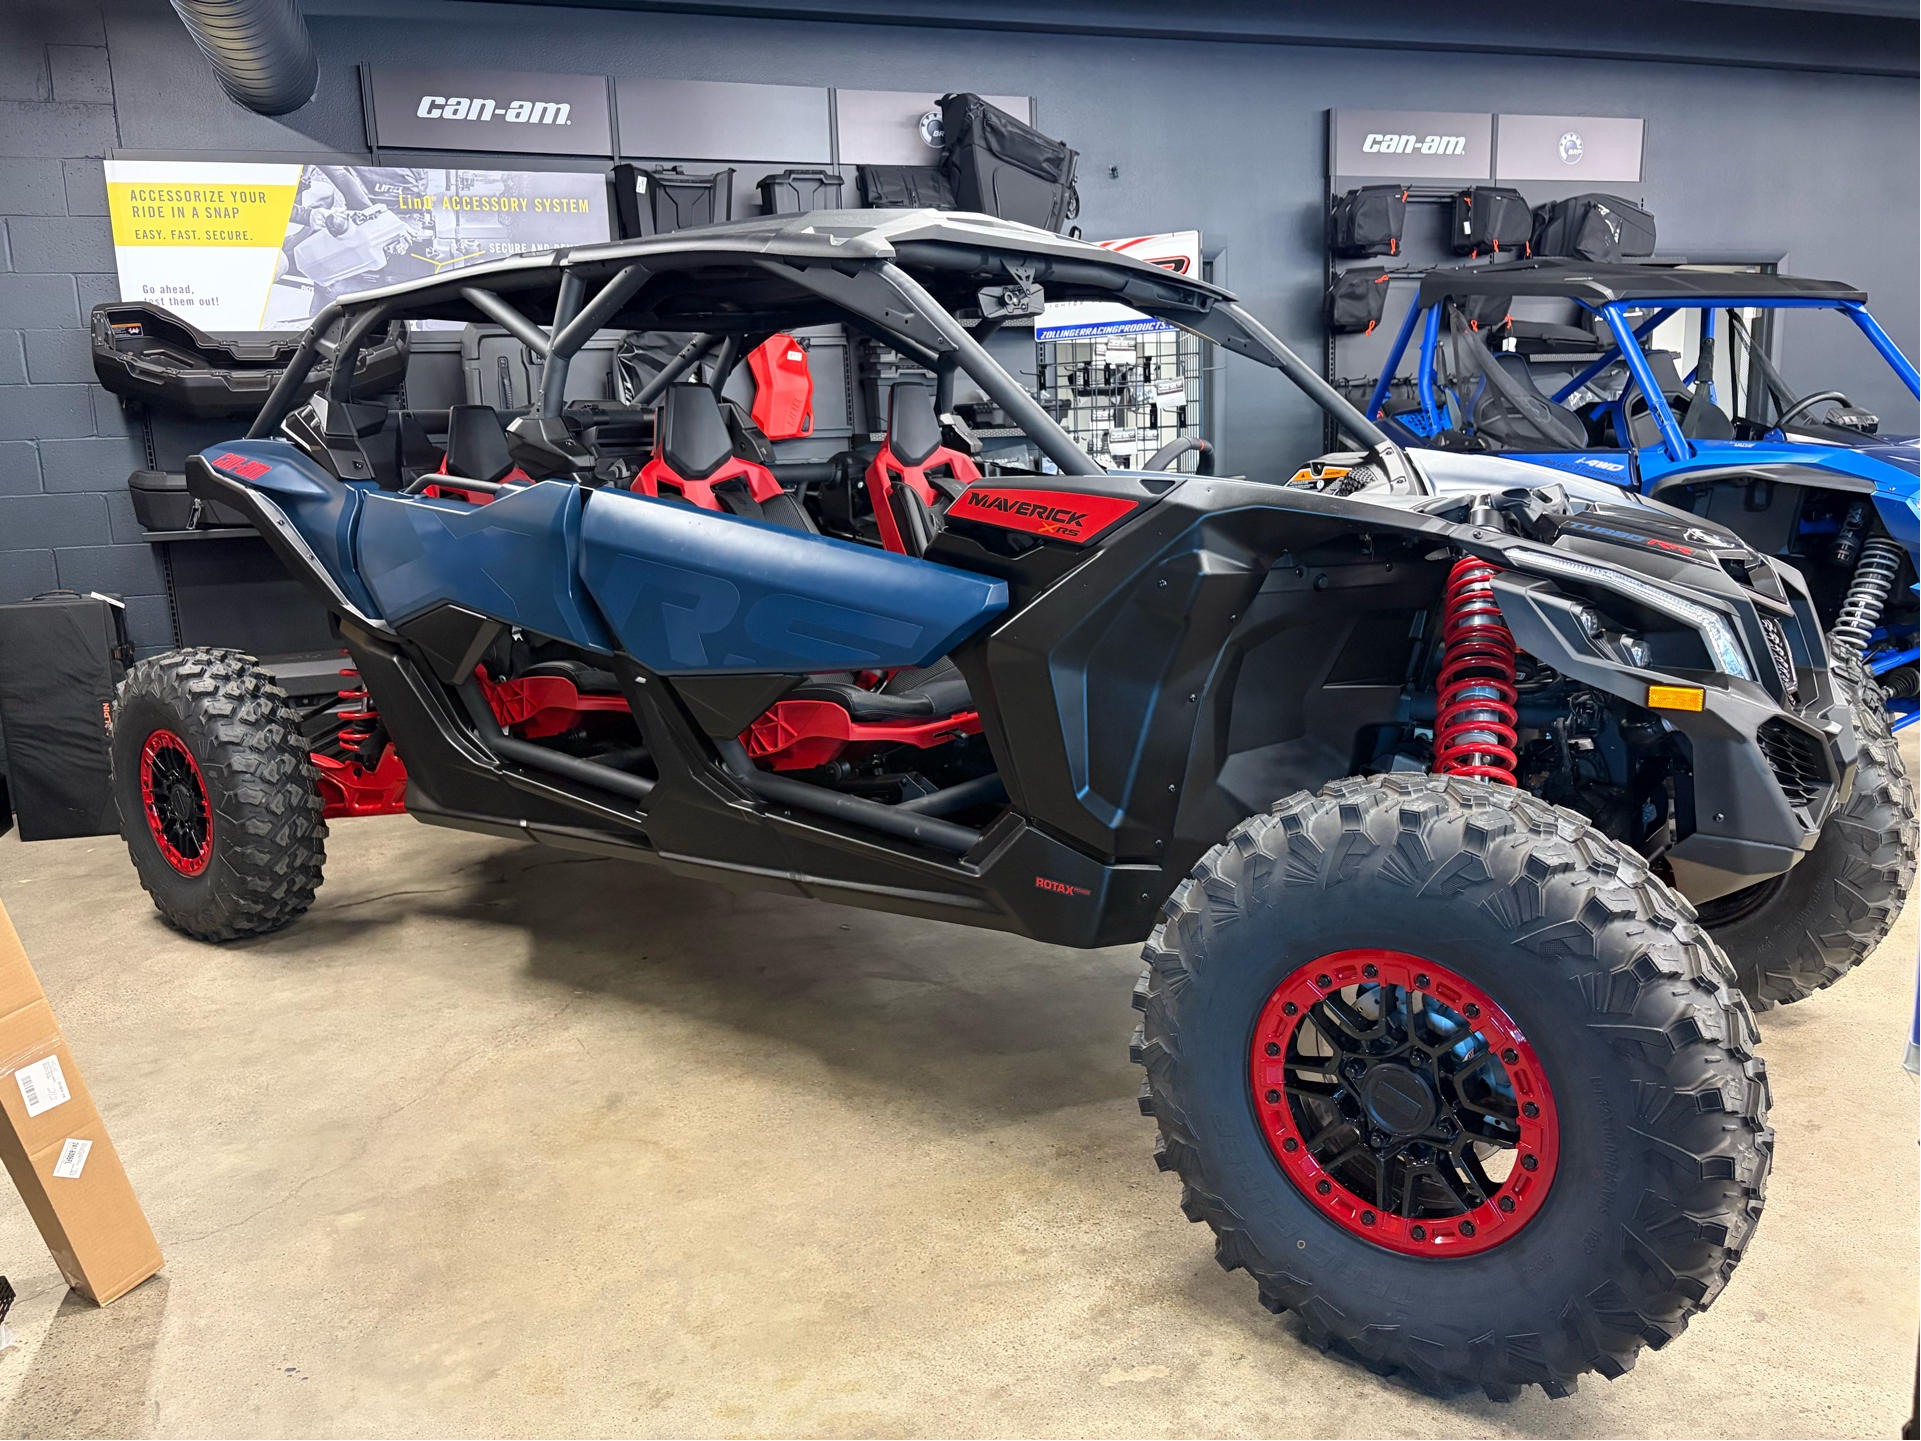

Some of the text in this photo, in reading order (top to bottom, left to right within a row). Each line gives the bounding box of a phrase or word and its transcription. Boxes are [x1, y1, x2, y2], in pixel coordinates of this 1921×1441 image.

[130, 189, 267, 203] ACCESSORIZE YOUR
[443, 196, 528, 212] ACCESSORY
[535, 199, 589, 213] SYSTEM
[132, 206, 240, 219] RIDE IN A SNAP
[135, 229, 253, 241] EASY. FAST. SECURE.
[489, 243, 527, 253] SECURE
[531, 243, 550, 251] AND
[142, 285, 195, 295] Go ahead,
[169, 297, 194, 306] them
[199, 297, 219, 306] out!
[1580, 465, 1626, 482] Transmission
[968, 492, 1089, 527] MAVERICK
[1839, 508, 1862, 538] FOX
[1568, 521, 1693, 556] TURBO RR
[1036, 877, 1074, 896] ROTAX
